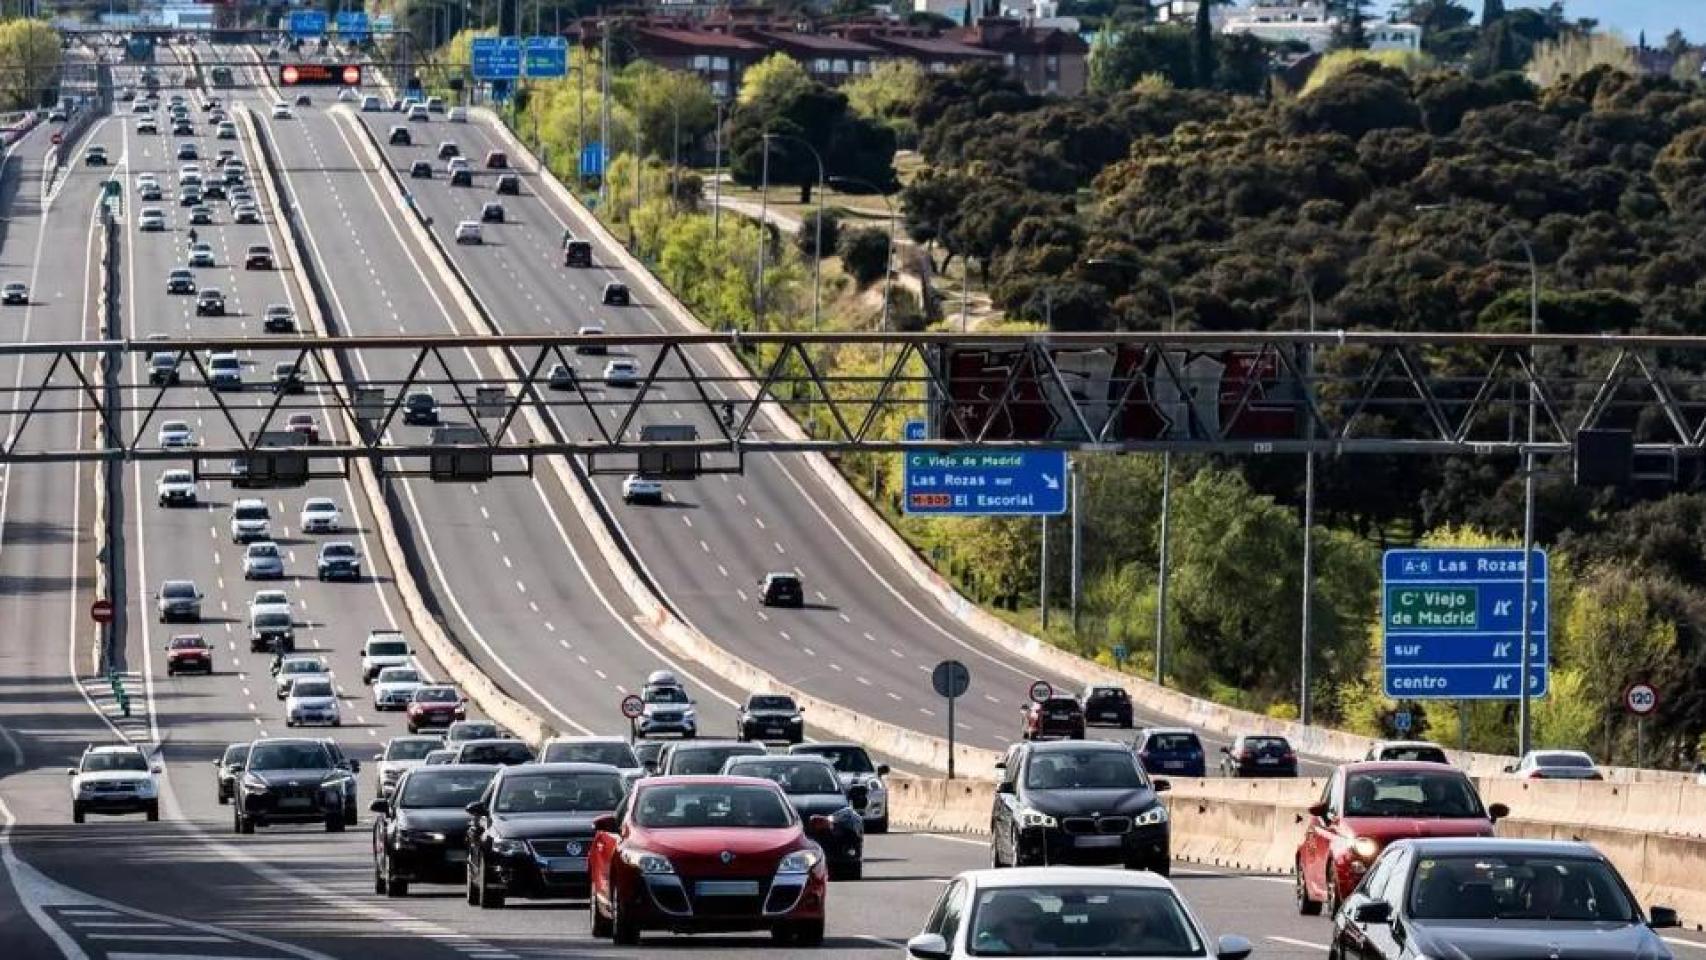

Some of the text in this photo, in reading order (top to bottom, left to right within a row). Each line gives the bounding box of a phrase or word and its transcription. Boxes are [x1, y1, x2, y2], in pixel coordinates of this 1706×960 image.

[928, 456, 957, 468] Viejo
[962, 456, 977, 465] de
[982, 456, 1021, 465] Madrid
[912, 474, 1013, 486] Las Rozas sur
[955, 494, 968, 506] El
[977, 494, 1034, 506] Escorial
[1404, 558, 1525, 572] A-6 Las Rozas
[1424, 592, 1466, 608] Viejo
[1392, 612, 1475, 625] de Madrid
[1394, 644, 1422, 656] sur
[1392, 673, 1448, 689] centro
[1631, 692, 1652, 705] 120
